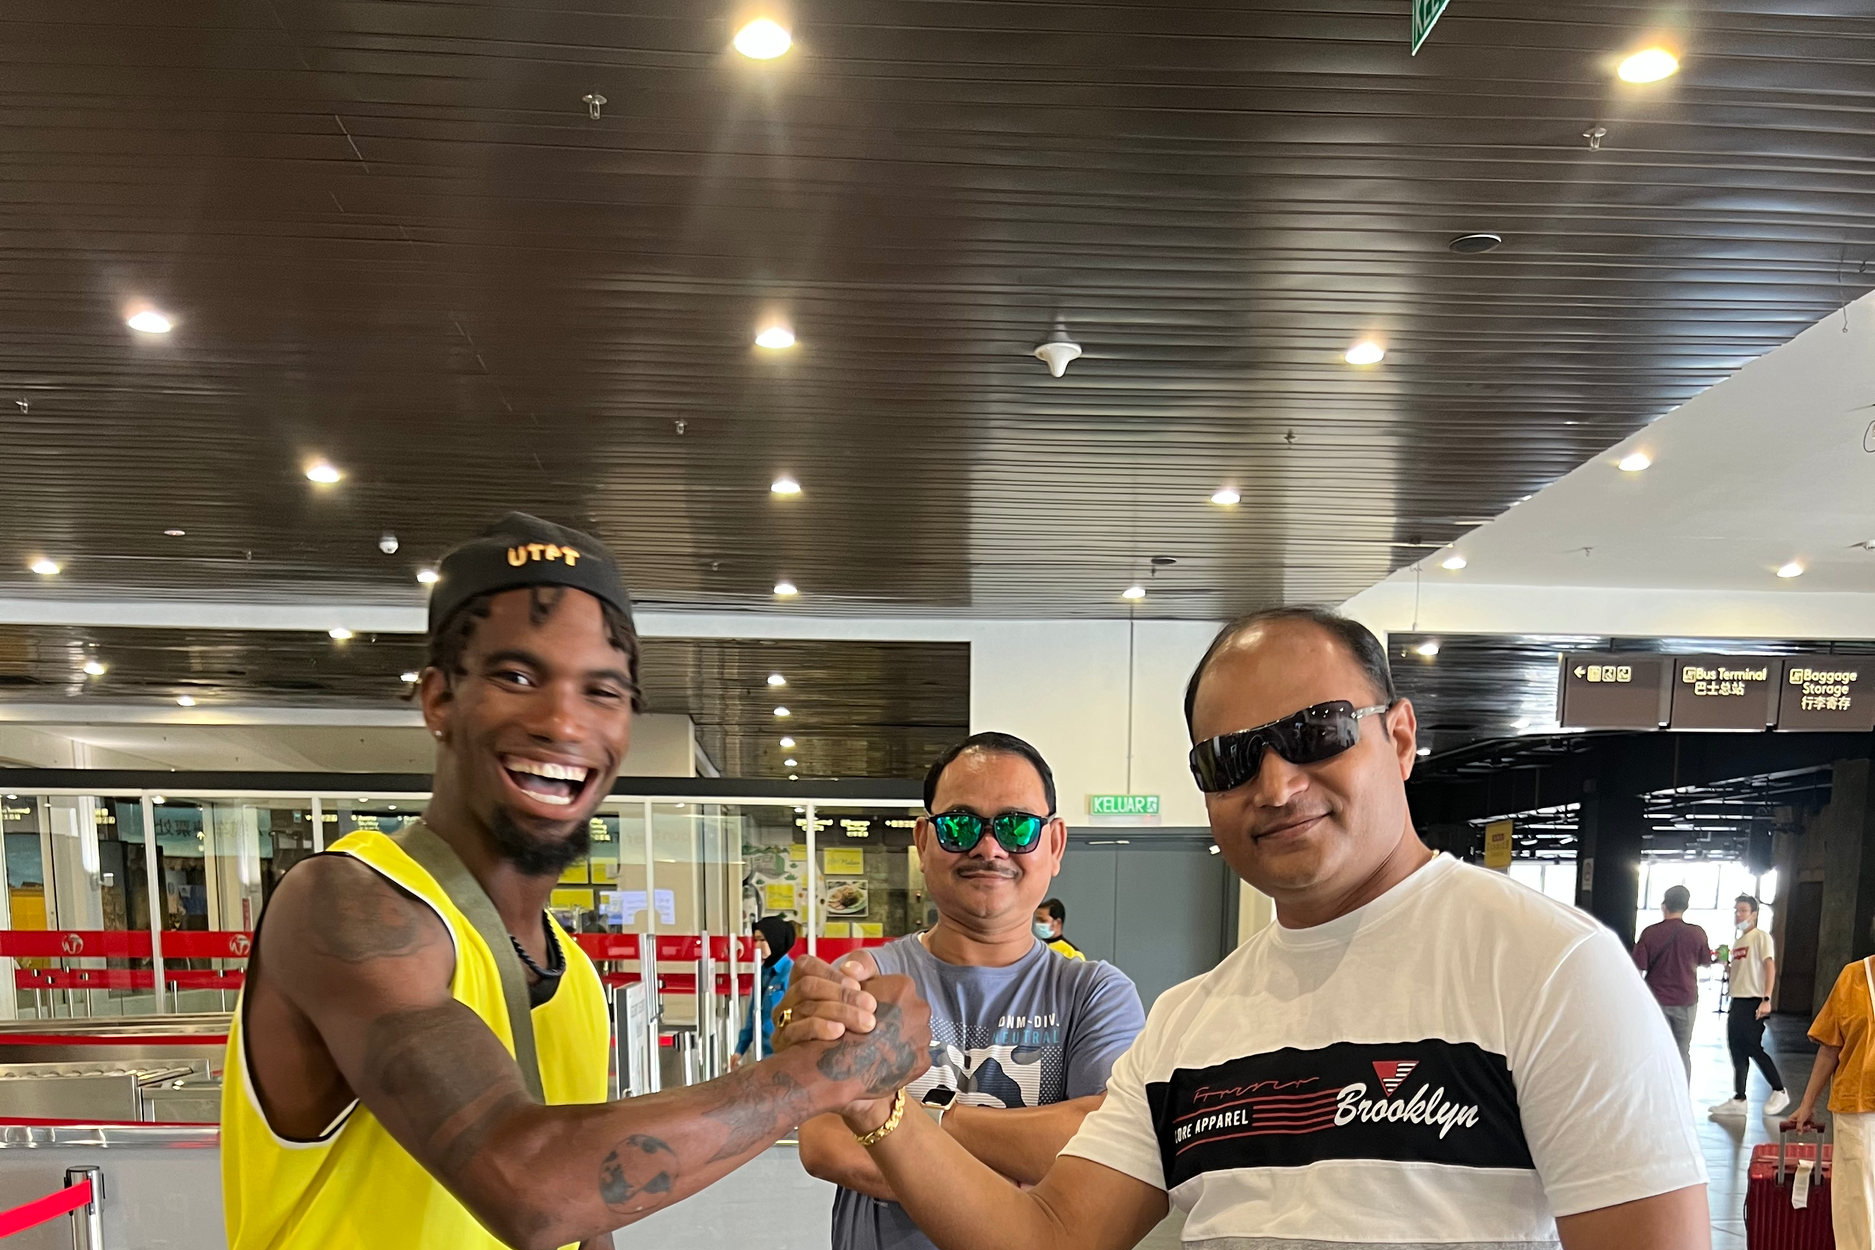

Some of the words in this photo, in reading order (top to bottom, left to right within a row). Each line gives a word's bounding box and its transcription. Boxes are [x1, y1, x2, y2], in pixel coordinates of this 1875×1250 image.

[1696, 667, 1716, 681] Bus
[1717, 667, 1767, 681] Terminal
[1804, 669, 1857, 685] Baggage
[1694, 682, 1745, 696] 巴士总站
[1802, 683, 1849, 697] Storage
[1801, 696, 1851, 711] 行李寄存
[1093, 796, 1145, 813] KELUAR
[993, 1030, 1059, 1044] NEUTRAL
[1334, 1082, 1480, 1140] Brooklyn
[1194, 1109, 1249, 1135] APPAREL
